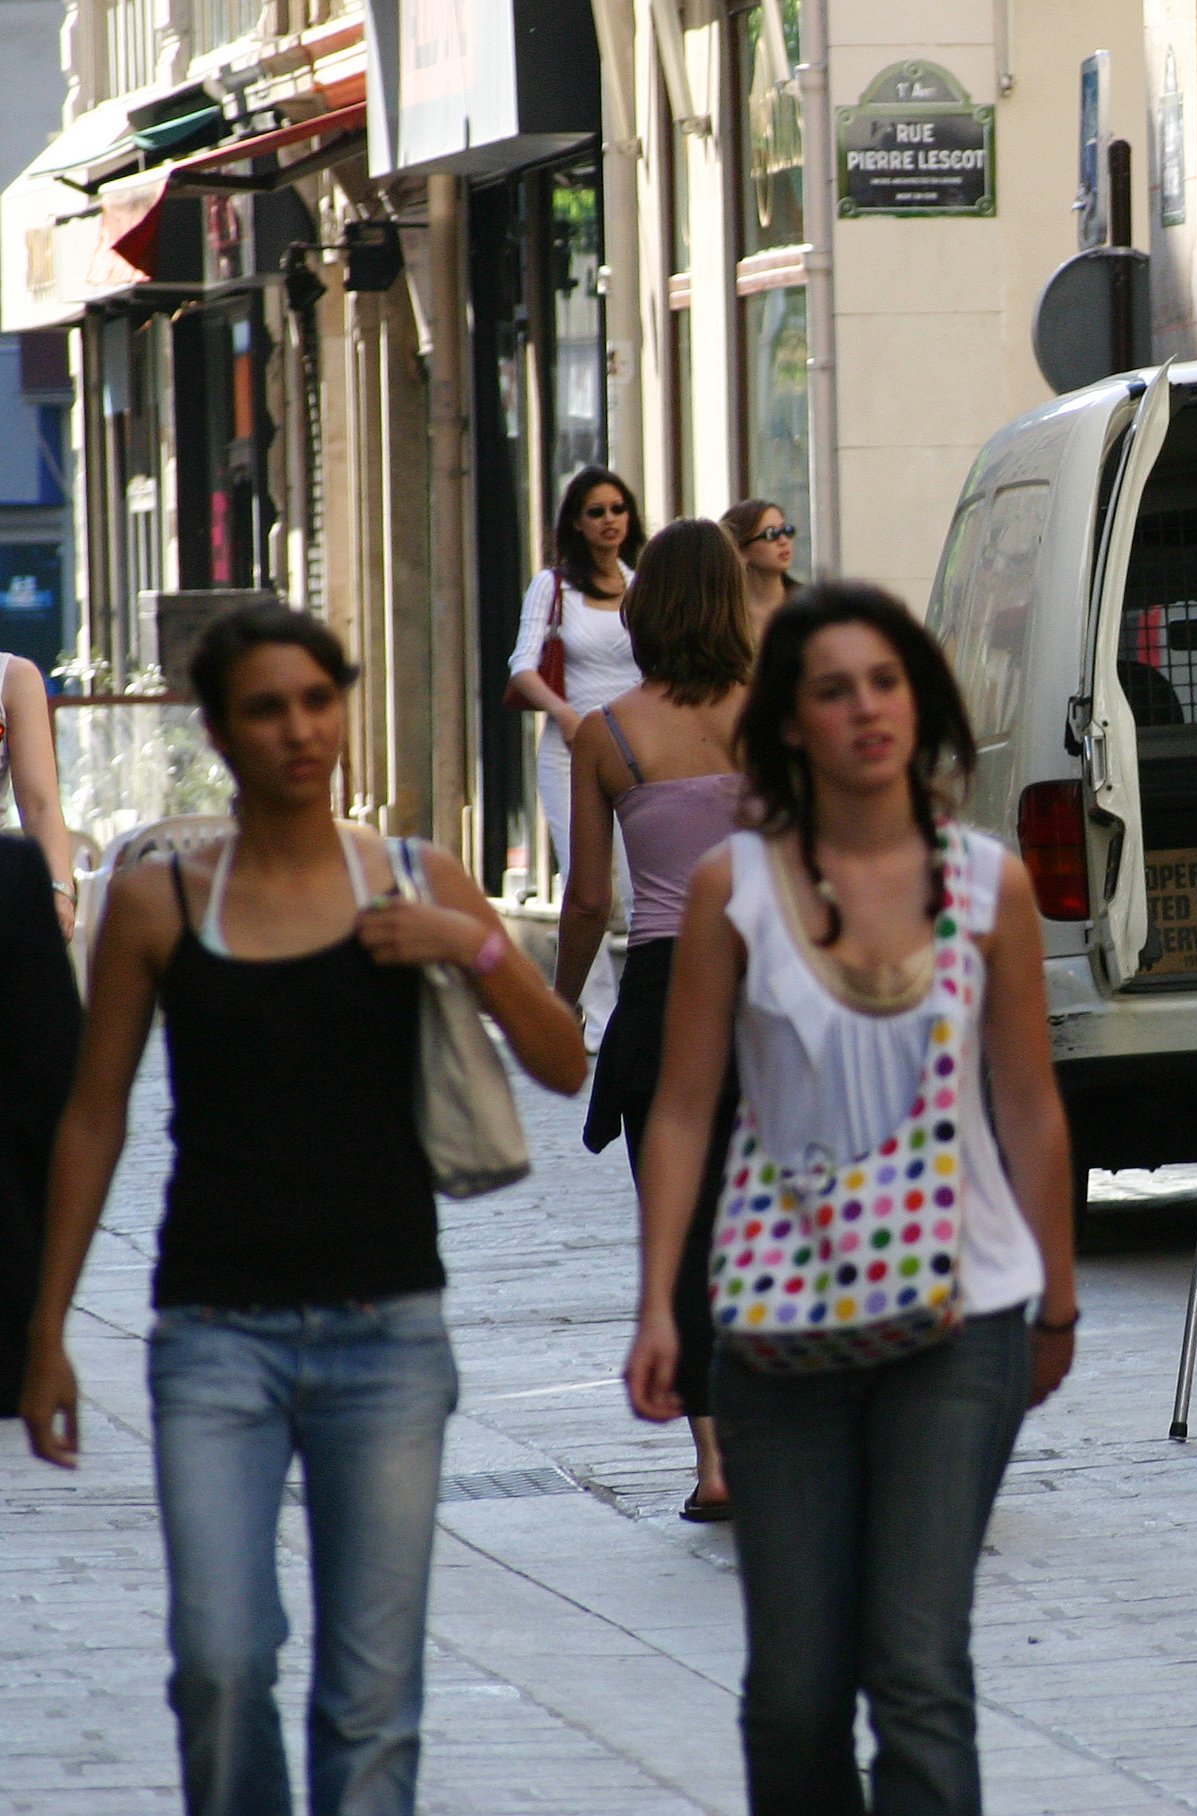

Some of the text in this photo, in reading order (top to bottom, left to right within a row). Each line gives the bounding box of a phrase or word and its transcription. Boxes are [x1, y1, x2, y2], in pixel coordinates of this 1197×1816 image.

[896, 123, 936, 143] RUE
[846, 150, 985, 171] PIERRE LESCOT
